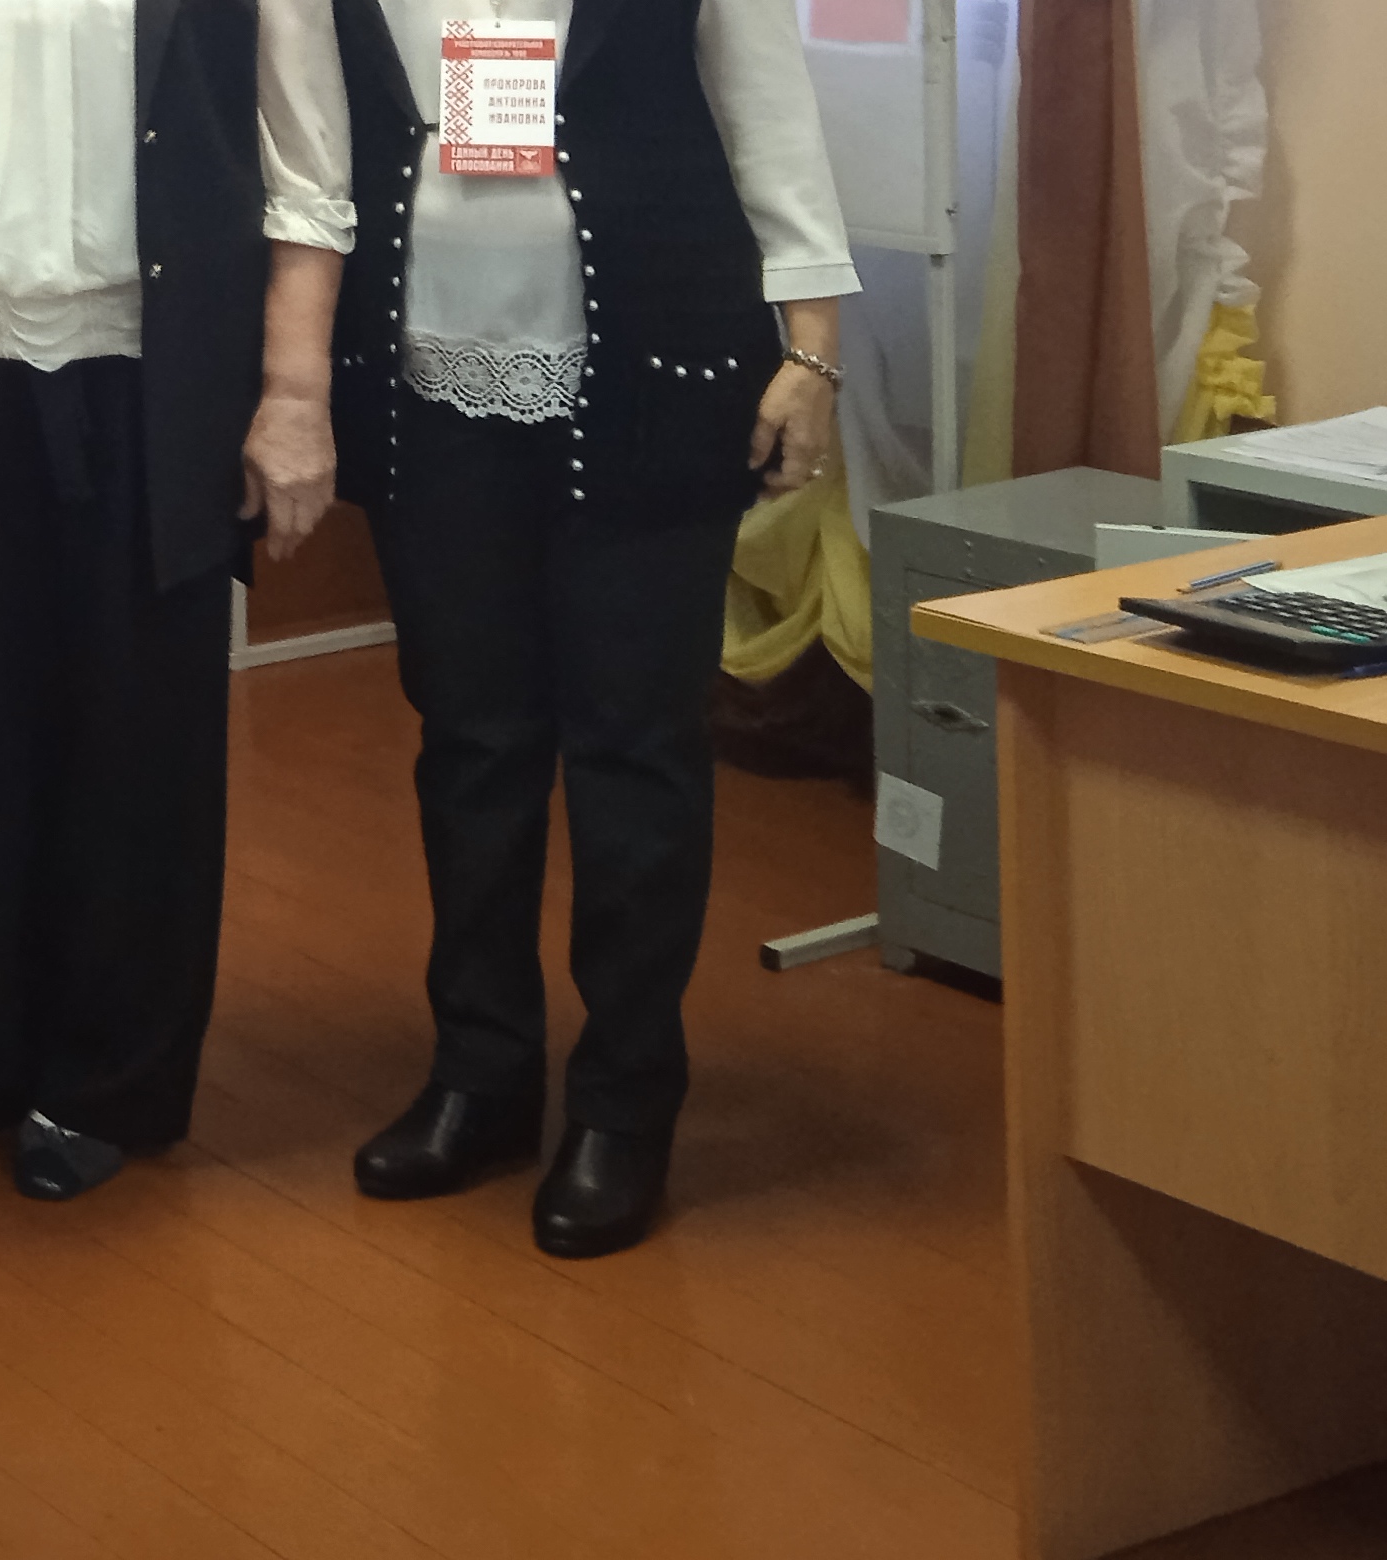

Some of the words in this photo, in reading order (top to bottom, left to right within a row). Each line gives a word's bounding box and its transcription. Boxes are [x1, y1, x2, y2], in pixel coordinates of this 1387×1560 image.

[483, 78, 546, 91] ПРОХОРОВА
[488, 96, 546, 108] АНТОНИНА
[488, 112, 546, 124] ИВАНОВНА
